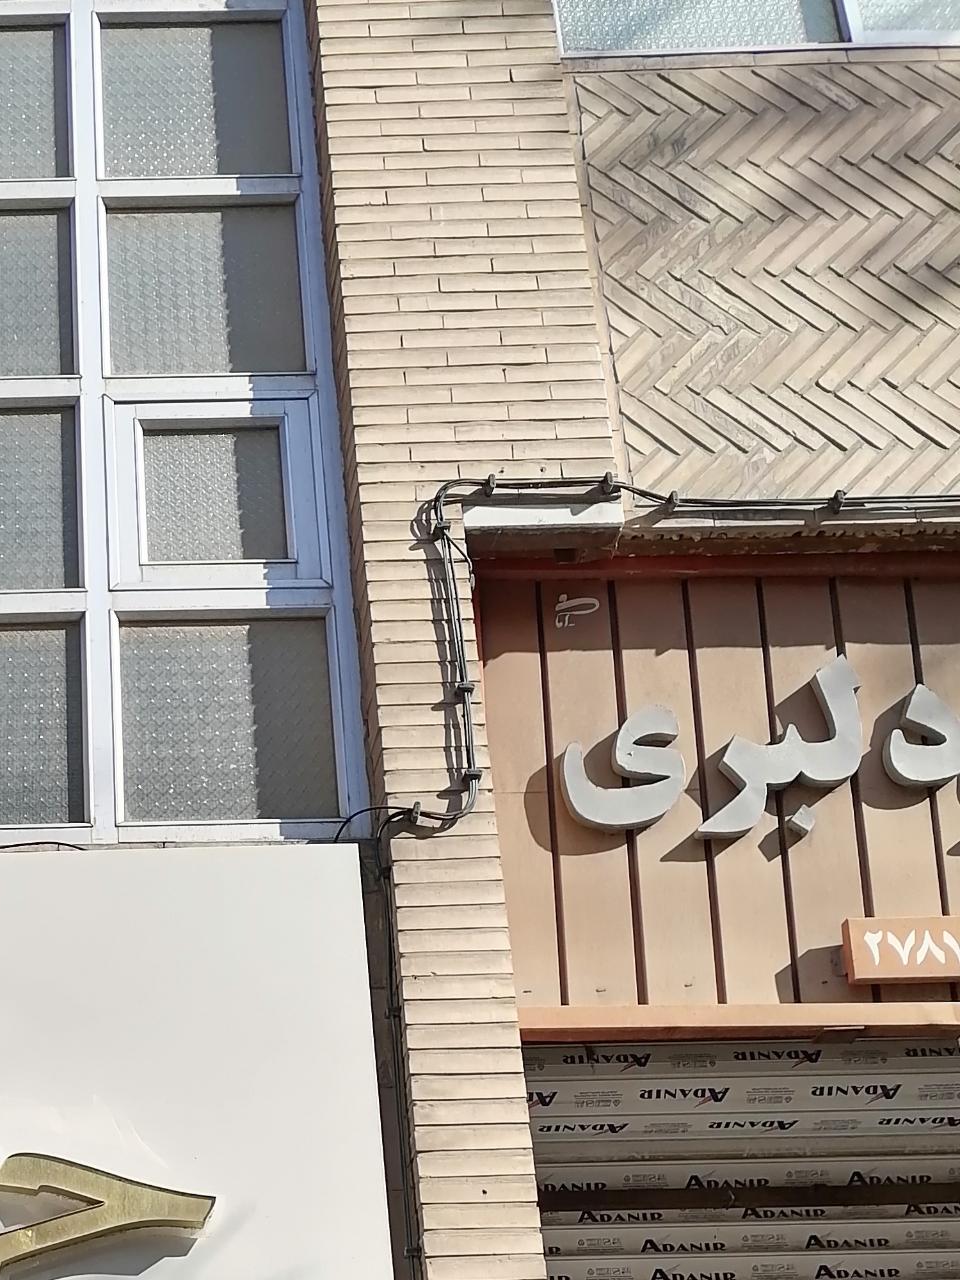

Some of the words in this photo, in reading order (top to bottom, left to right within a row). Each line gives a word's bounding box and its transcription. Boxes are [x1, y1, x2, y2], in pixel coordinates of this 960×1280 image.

[733, 1049, 823, 1064] ADANIR
[639, 1087, 731, 1102] ADANIR
[811, 1084, 903, 1100] ADANIR
[538, 1122, 630, 1134] ADANIR
[708, 1119, 800, 1131] ADANIR
[538, 1182, 607, 1192] DANIR
[577, 1210, 665, 1224] ADANIR
[741, 1207, 827, 1220] ADANIR
[641, 1238, 726, 1253] ADANIR
[805, 1234, 890, 1249] ADANIR
[815, 1264, 901, 1279] ADANIR
